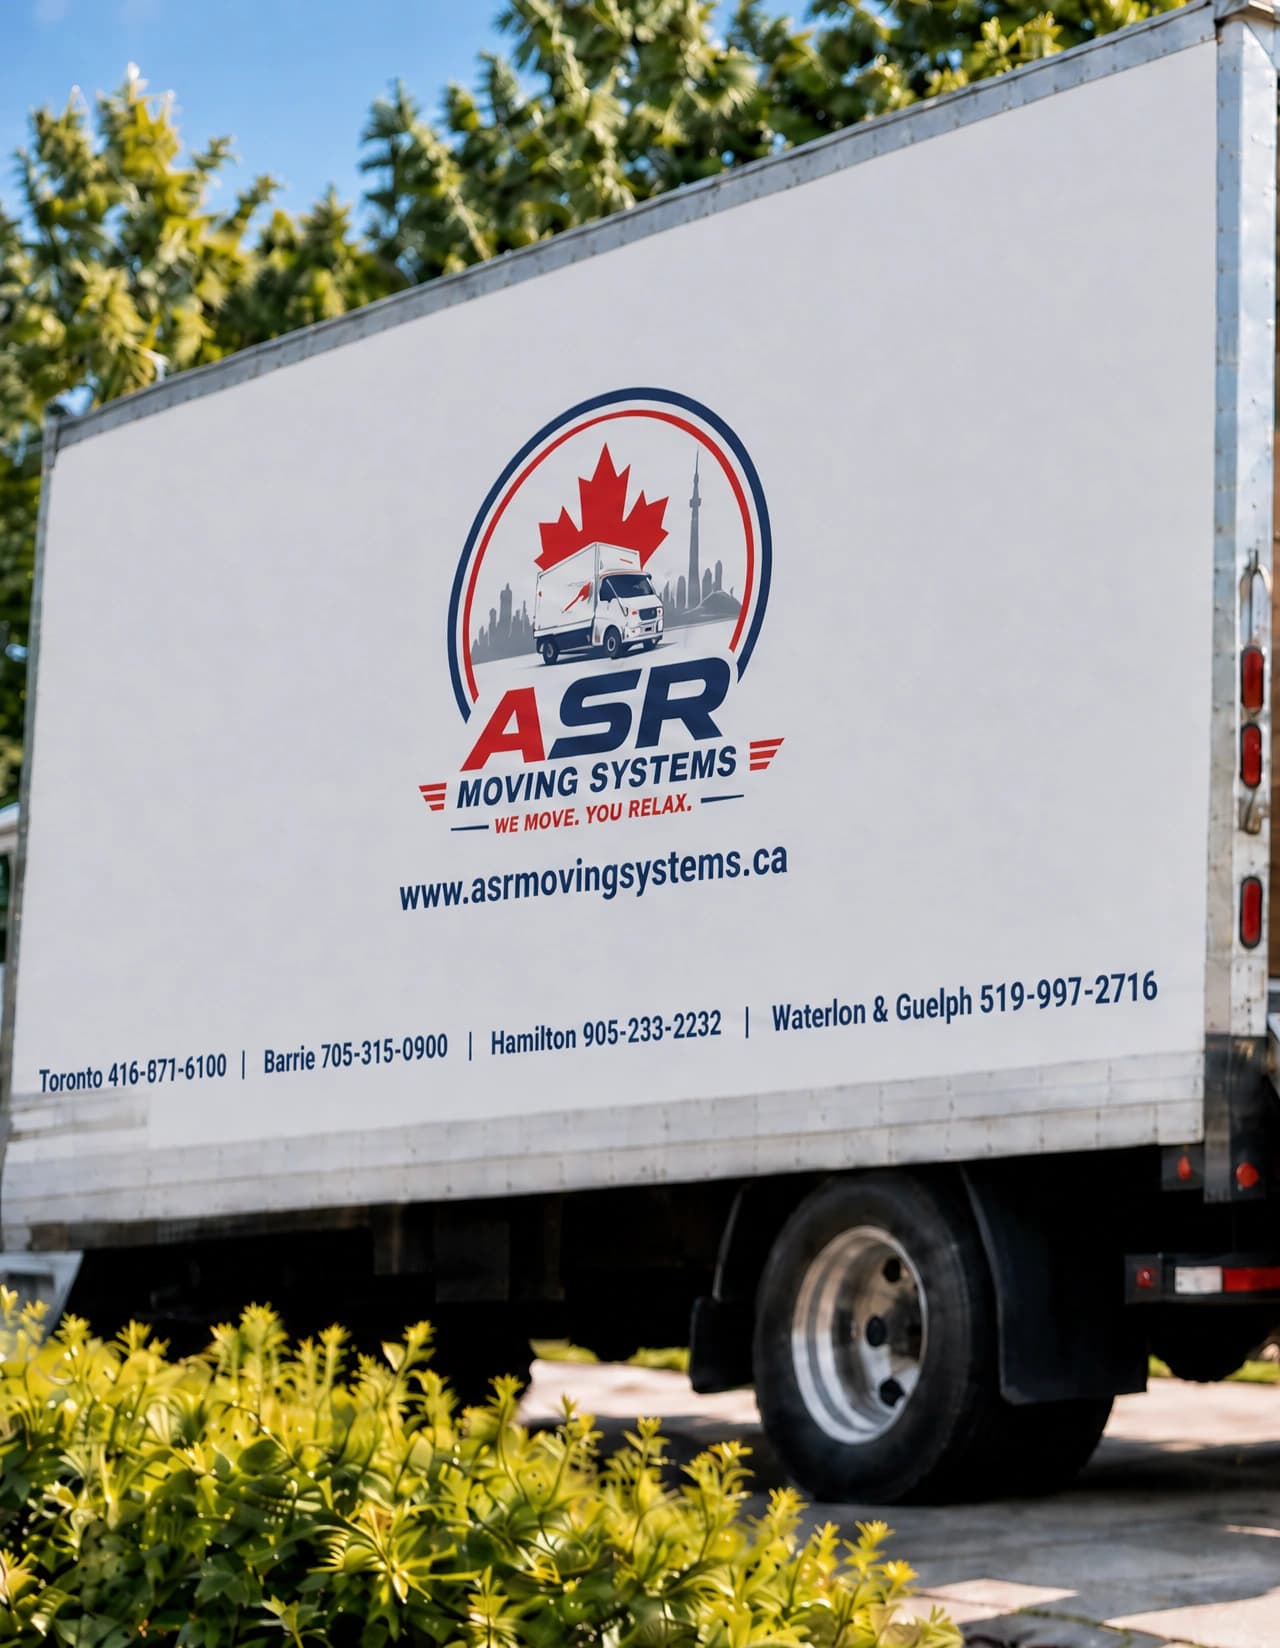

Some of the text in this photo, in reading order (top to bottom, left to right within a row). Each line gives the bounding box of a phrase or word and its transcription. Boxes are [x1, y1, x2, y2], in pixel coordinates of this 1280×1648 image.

[460, 656, 732, 772] ASR
[457, 745, 737, 810] MOVING SYSTEMS
[494, 793, 692, 834] WE MOVE. YOU RELAX.
[399, 846, 788, 911] www.asrmovingsystems.ca
[39, 969, 1158, 1093] Toronto 416-871-6100 Barrie 705-315-0900 Hamilton 905-233-2232 Waterlon & Guelph 519-997-2716
